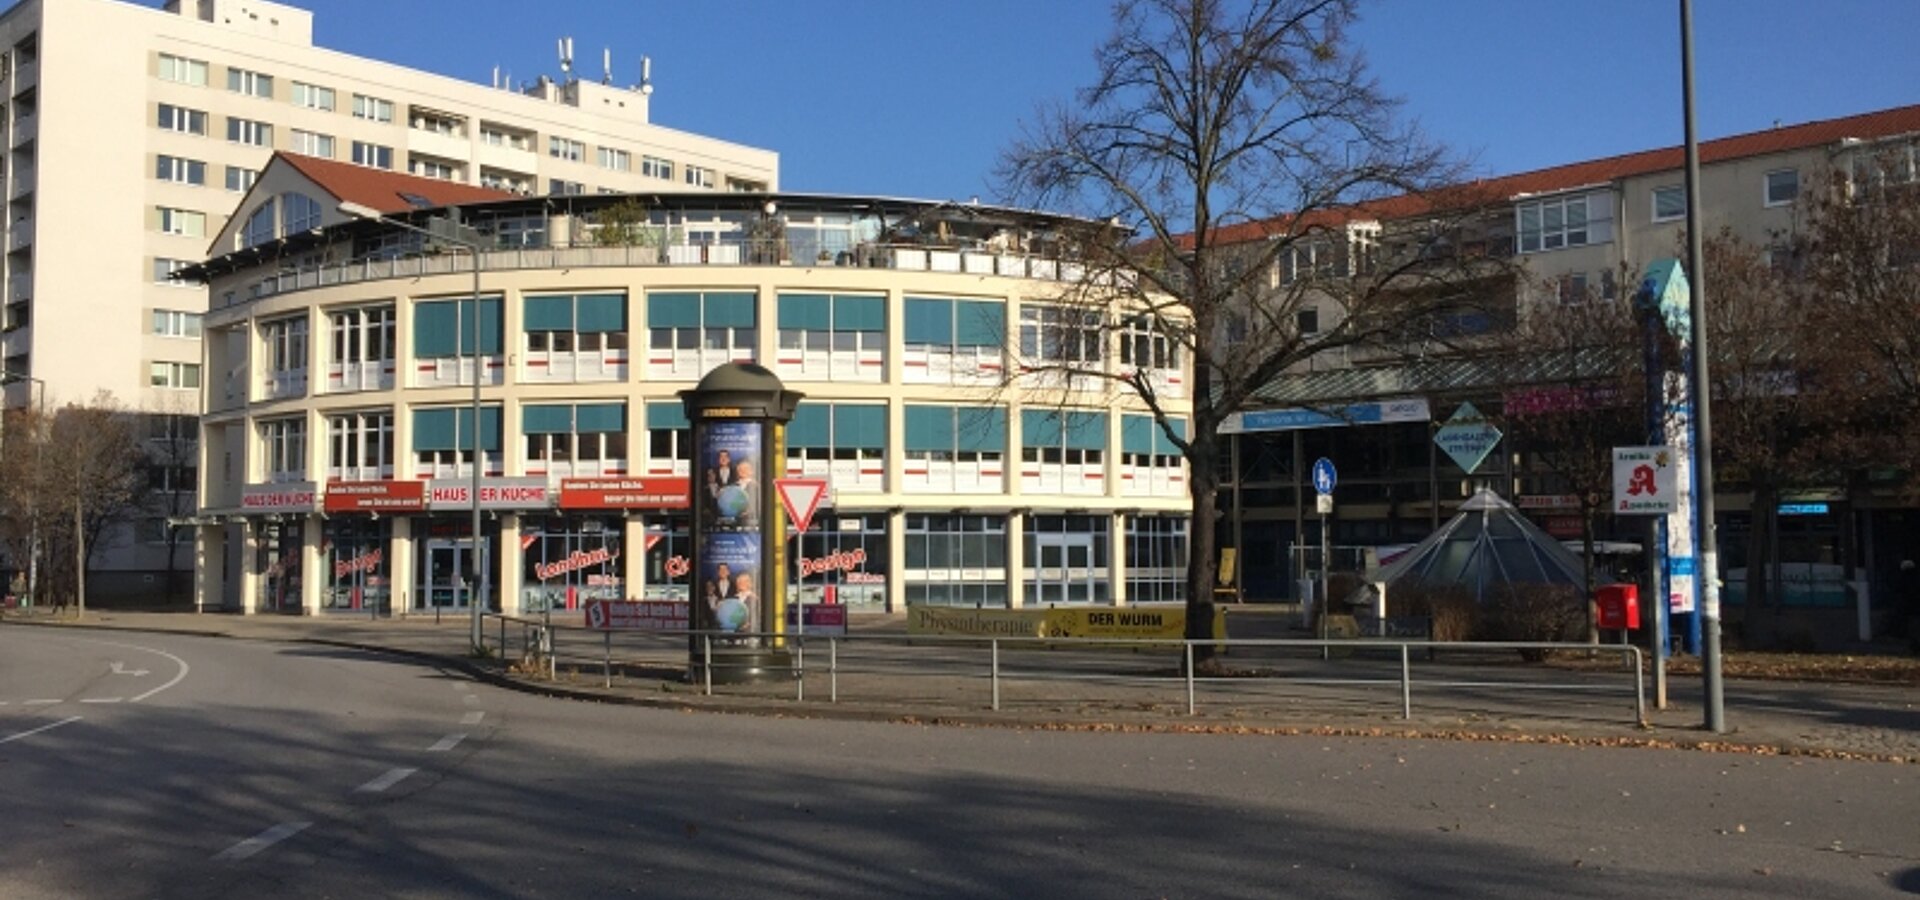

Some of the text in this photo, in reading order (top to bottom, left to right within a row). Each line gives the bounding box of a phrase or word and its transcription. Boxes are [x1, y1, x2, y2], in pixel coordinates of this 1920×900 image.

[434, 487, 468, 501] HAUS
[796, 548, 867, 577] Design
[1088, 612, 1115, 626] DER
[1118, 613, 1163, 627] WURM
